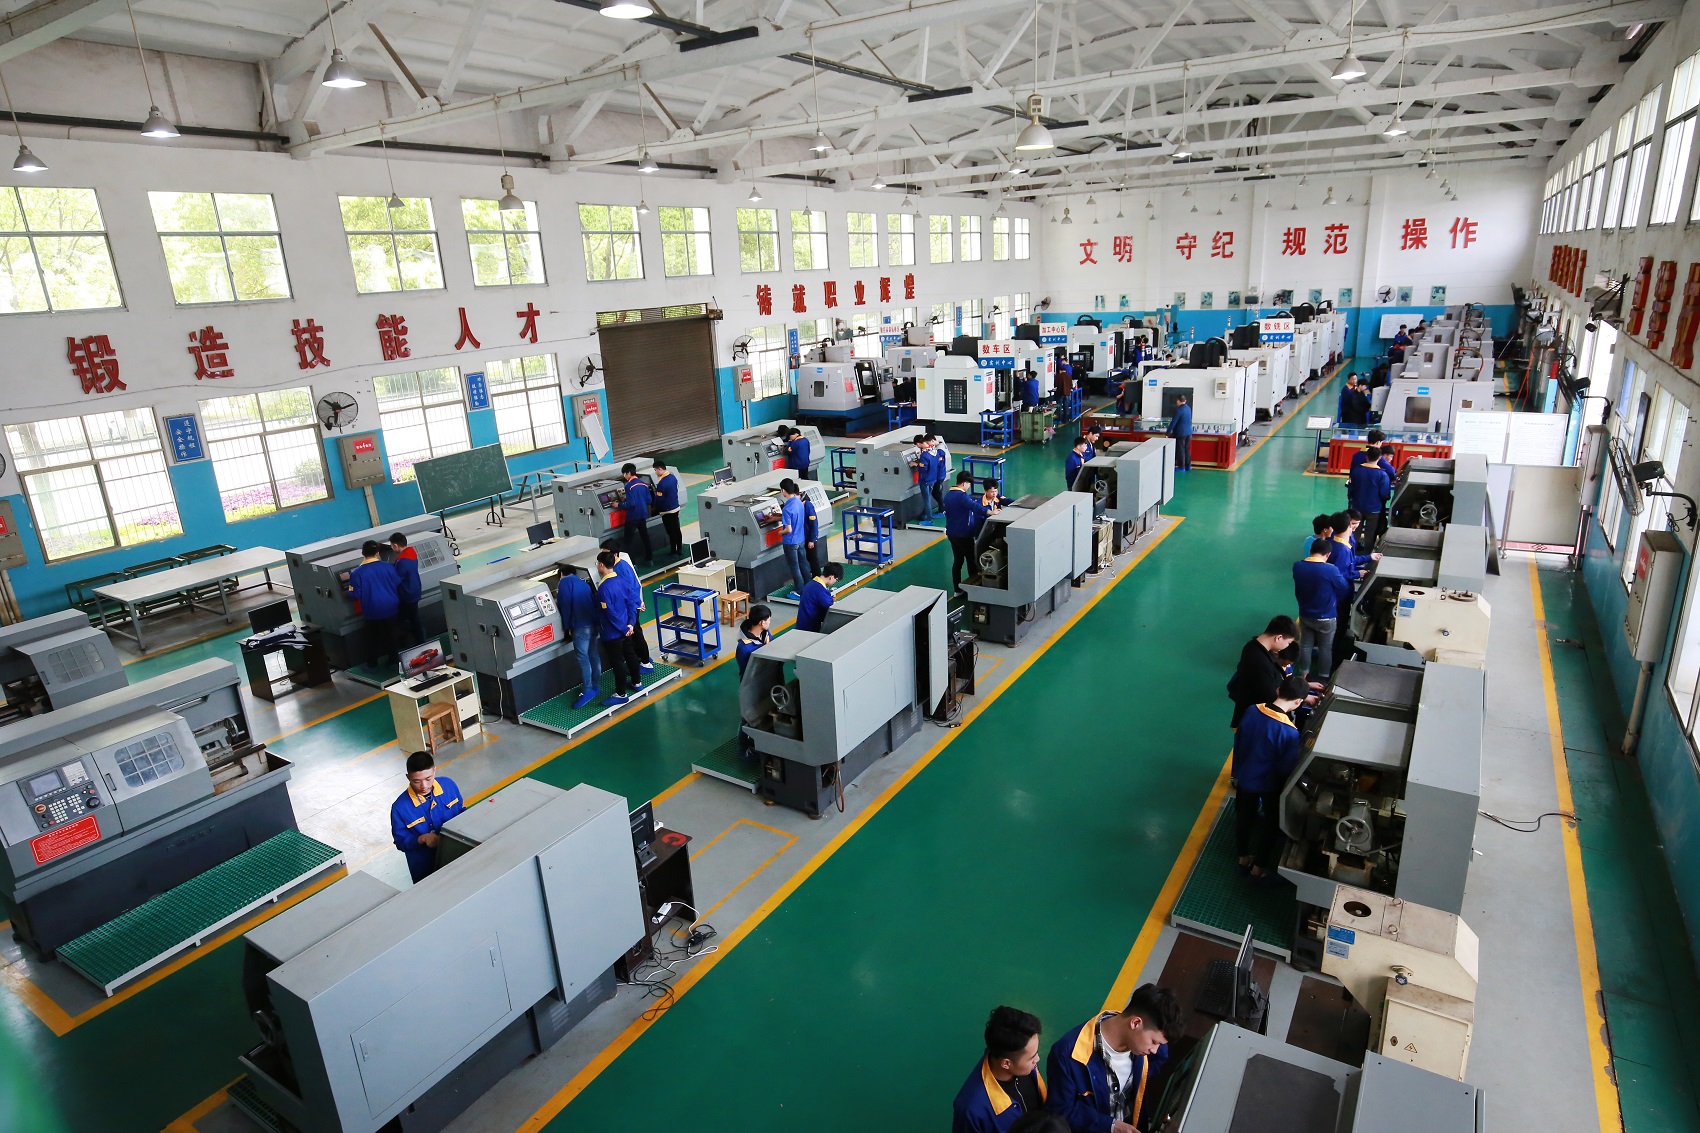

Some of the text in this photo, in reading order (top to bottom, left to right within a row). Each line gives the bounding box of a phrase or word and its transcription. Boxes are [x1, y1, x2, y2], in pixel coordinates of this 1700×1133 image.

[1079, 217, 1479, 266] 文明 守纪 规范 操作
[756, 273, 915, 316] 铸就职业辉煌
[66, 302, 541, 394] 锻造技能人才
[982, 343, 1010, 354] 数车区
[175, 428, 187, 457] 安全操作
